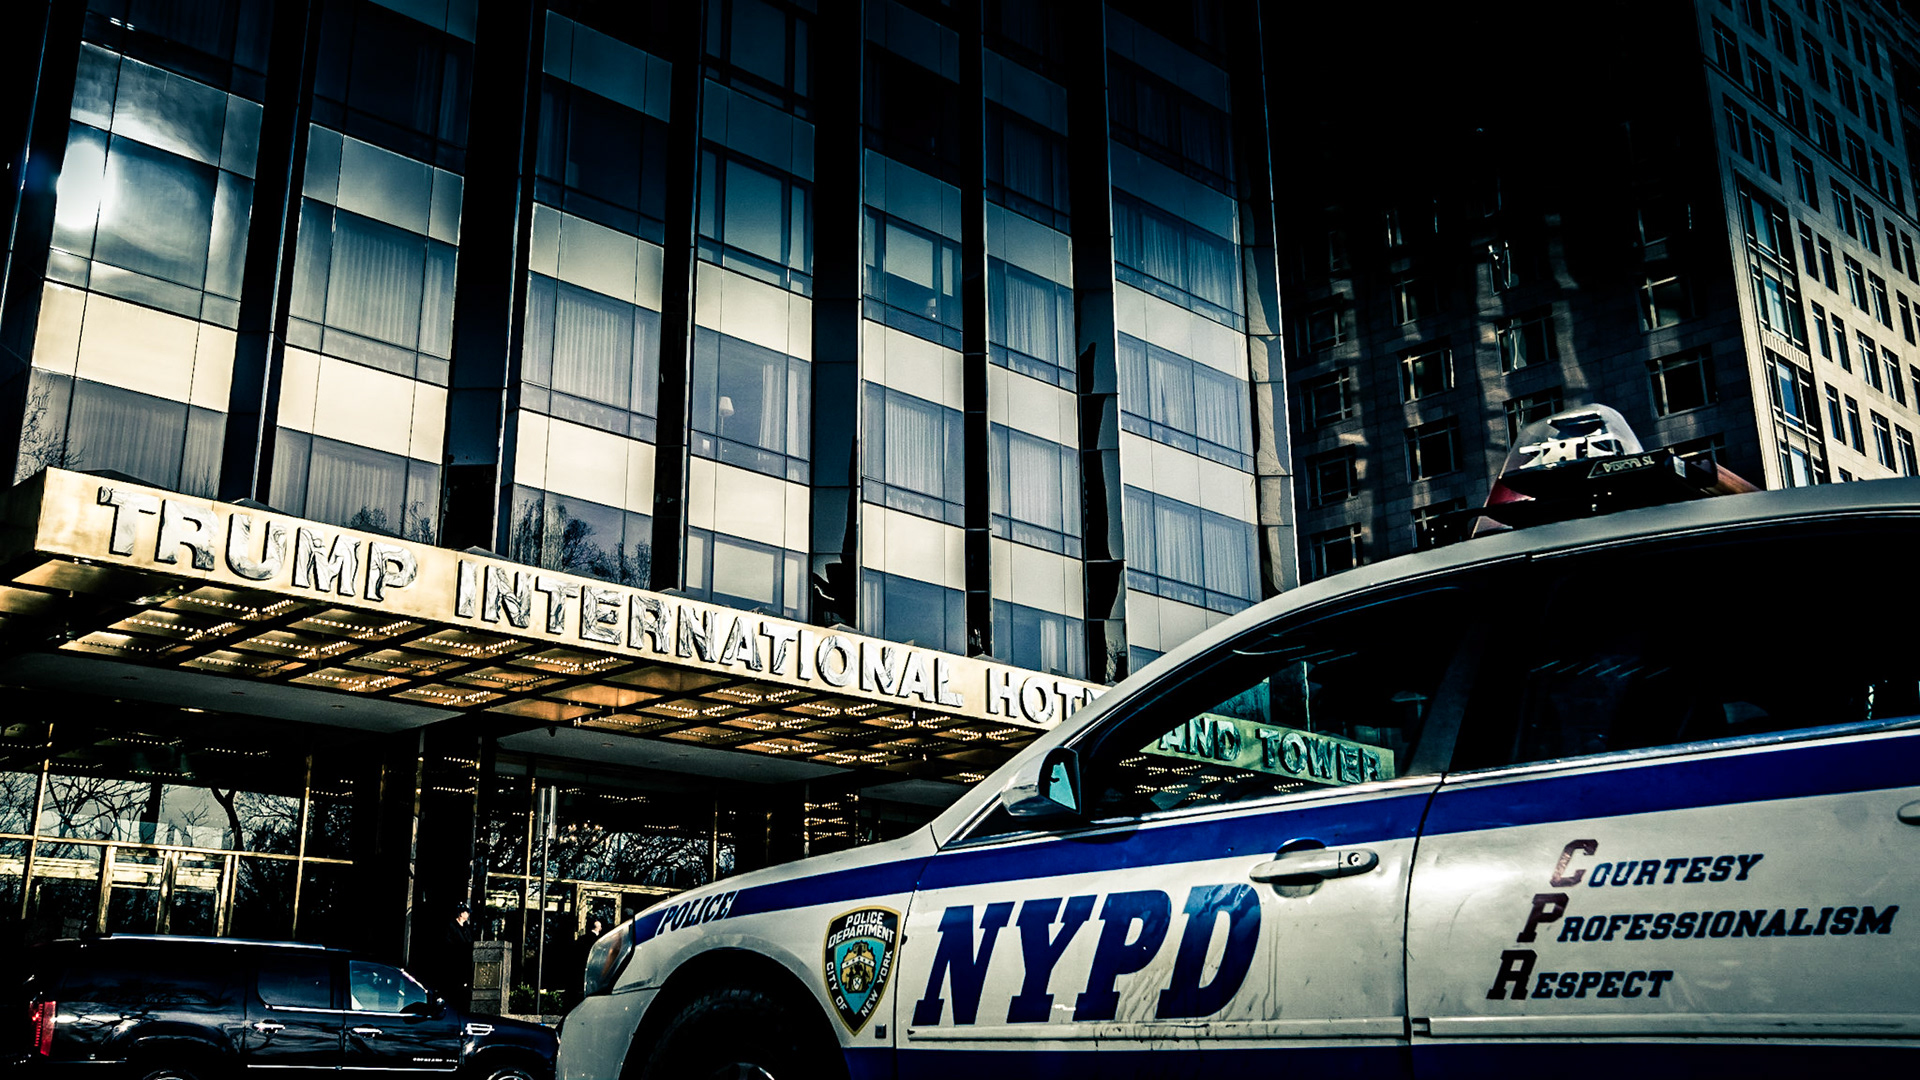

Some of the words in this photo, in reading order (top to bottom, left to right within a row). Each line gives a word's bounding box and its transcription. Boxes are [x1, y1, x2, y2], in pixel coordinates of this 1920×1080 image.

[99, 485, 418, 601] TRUMP
[456, 558, 964, 707] INTERNATIONAL
[1159, 717, 1242, 761] AND
[1255, 727, 1381, 784] TOWER
[1549, 838, 1764, 888] COURTESY
[655, 889, 739, 937] POLICE
[827, 924, 895, 949] DEPARTMENT
[845, 911, 885, 928] POLICE
[1516, 892, 1899, 943] PROFESSIONALISM
[911, 882, 1263, 1027] NYPD
[1486, 948, 1674, 1001] RESPECT
[826, 961, 839, 991] CITY
[835, 995, 848, 1011] OF
[861, 989, 879, 1017] NEW
[877, 950, 893, 984] YORK
